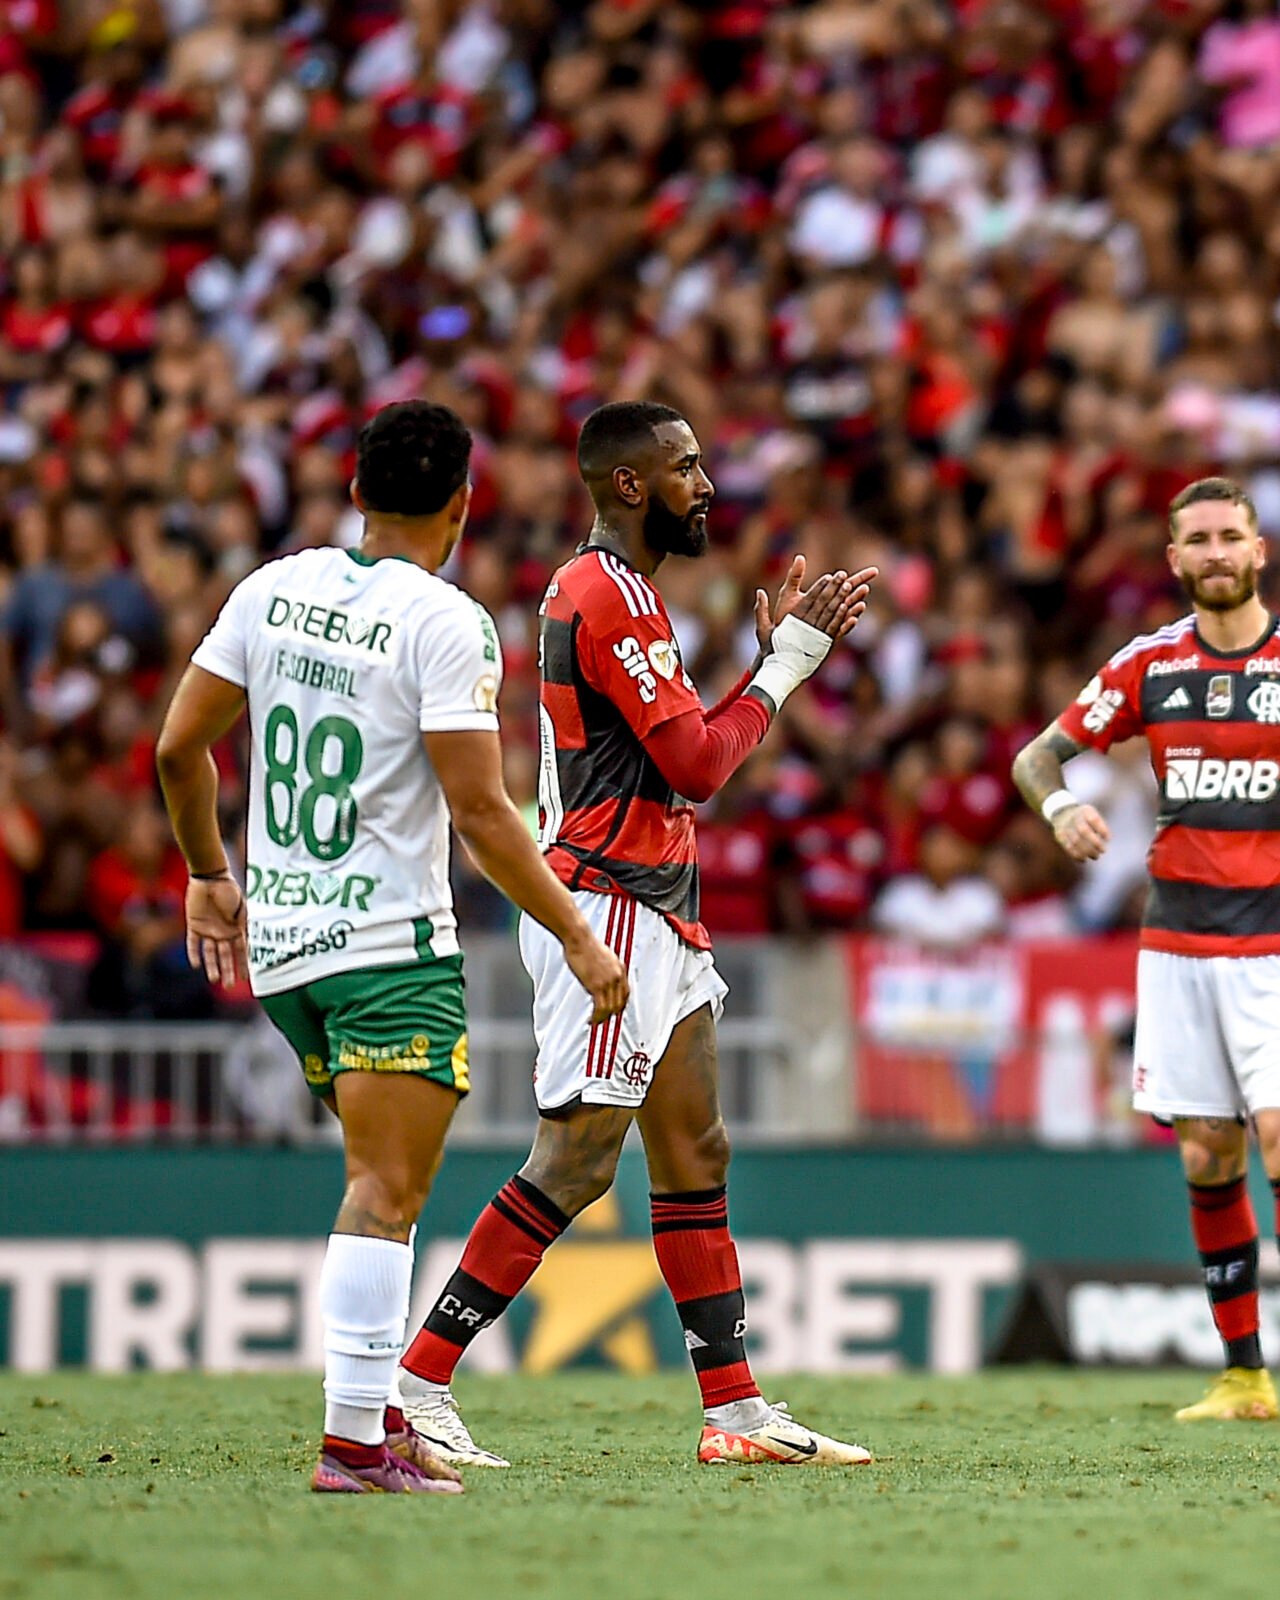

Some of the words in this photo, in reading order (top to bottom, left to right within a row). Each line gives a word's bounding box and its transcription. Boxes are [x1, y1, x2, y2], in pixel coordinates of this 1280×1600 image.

[266, 596, 392, 654] DREBOR
[1148, 655, 1199, 677] pixbet
[1165, 746, 1201, 758] banco
[265, 705, 363, 861] 88
[1195, 760, 1280, 800] BRB
[1202, 1260, 1246, 1283] RF
[741, 1240, 1022, 1371] BET
